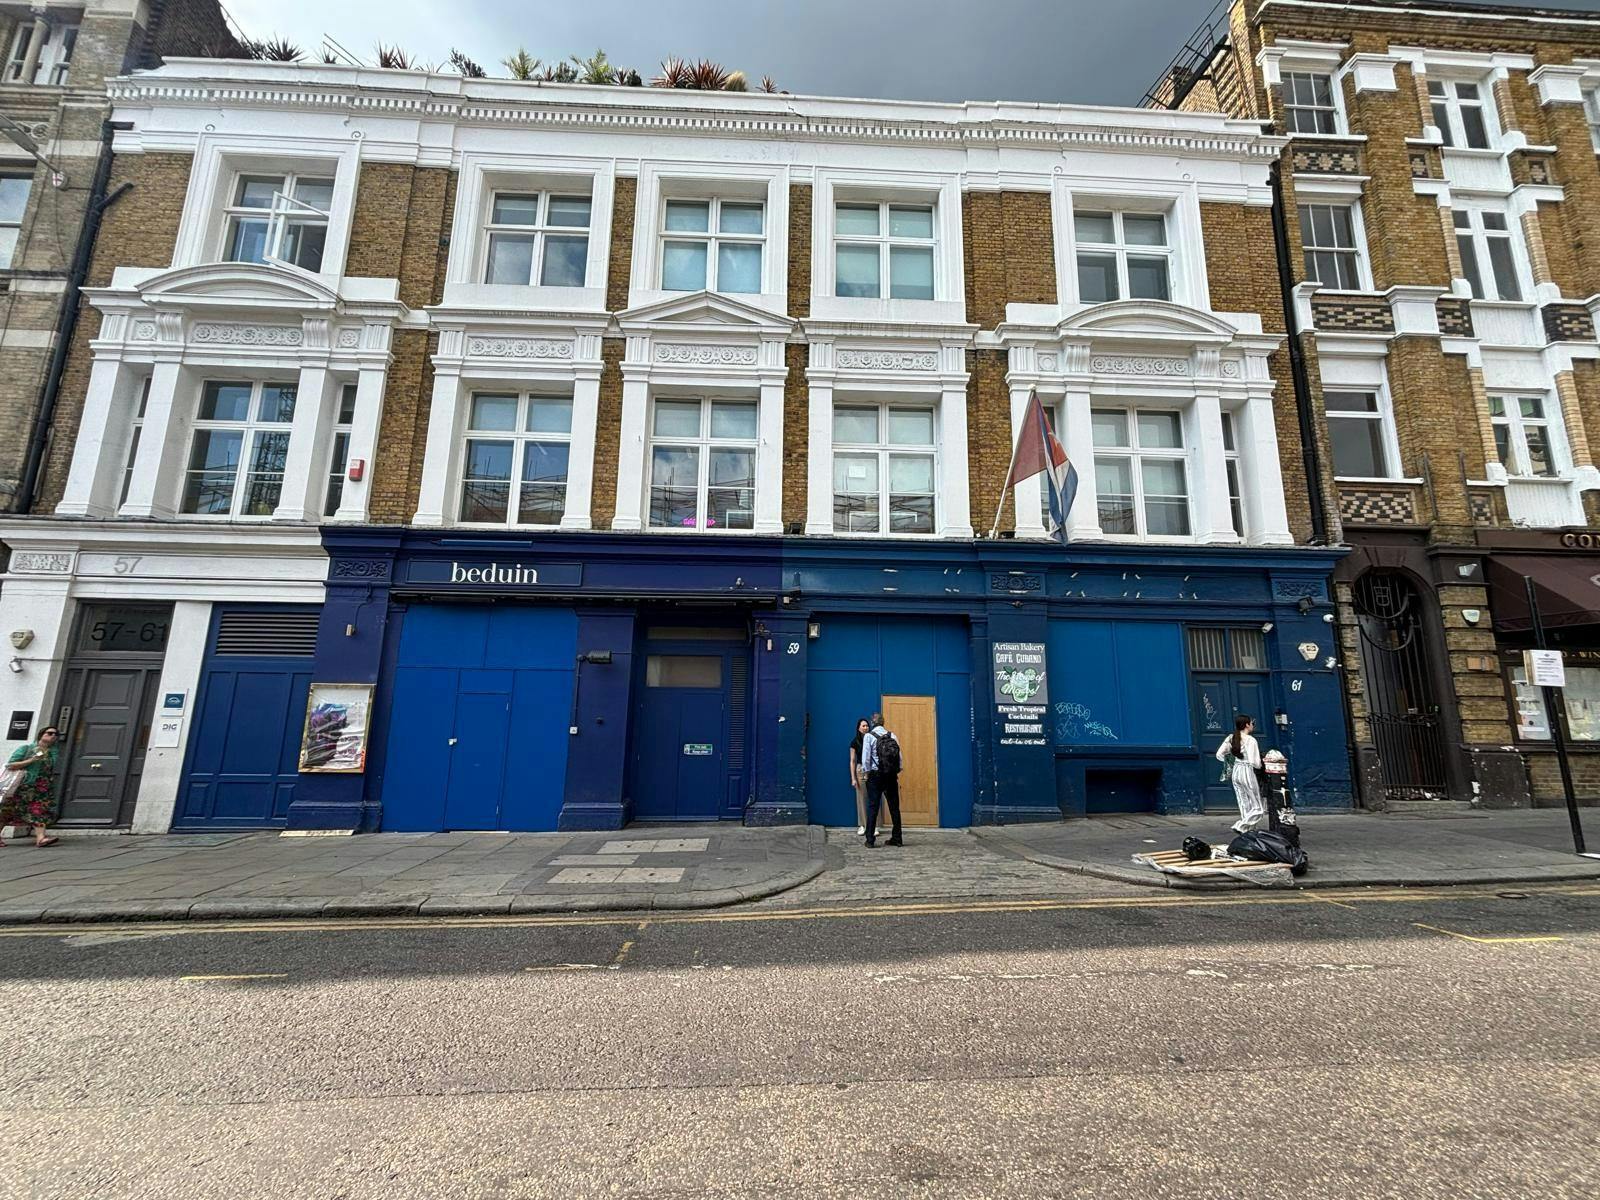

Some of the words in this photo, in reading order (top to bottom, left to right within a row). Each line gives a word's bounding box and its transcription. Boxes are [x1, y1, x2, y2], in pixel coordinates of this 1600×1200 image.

[113, 556, 143, 574] 57
[451, 562, 538, 584] beduin
[91, 621, 169, 642] 57-61
[787, 642, 800, 654] 59
[994, 643, 1019, 651] Artisan
[1020, 643, 1046, 653] Bakery
[996, 651, 1013, 663] CAFÉ
[996, 670, 1010, 680] The
[1291, 679, 1303, 691] 61
[1018, 705, 1046, 713] Tropical
